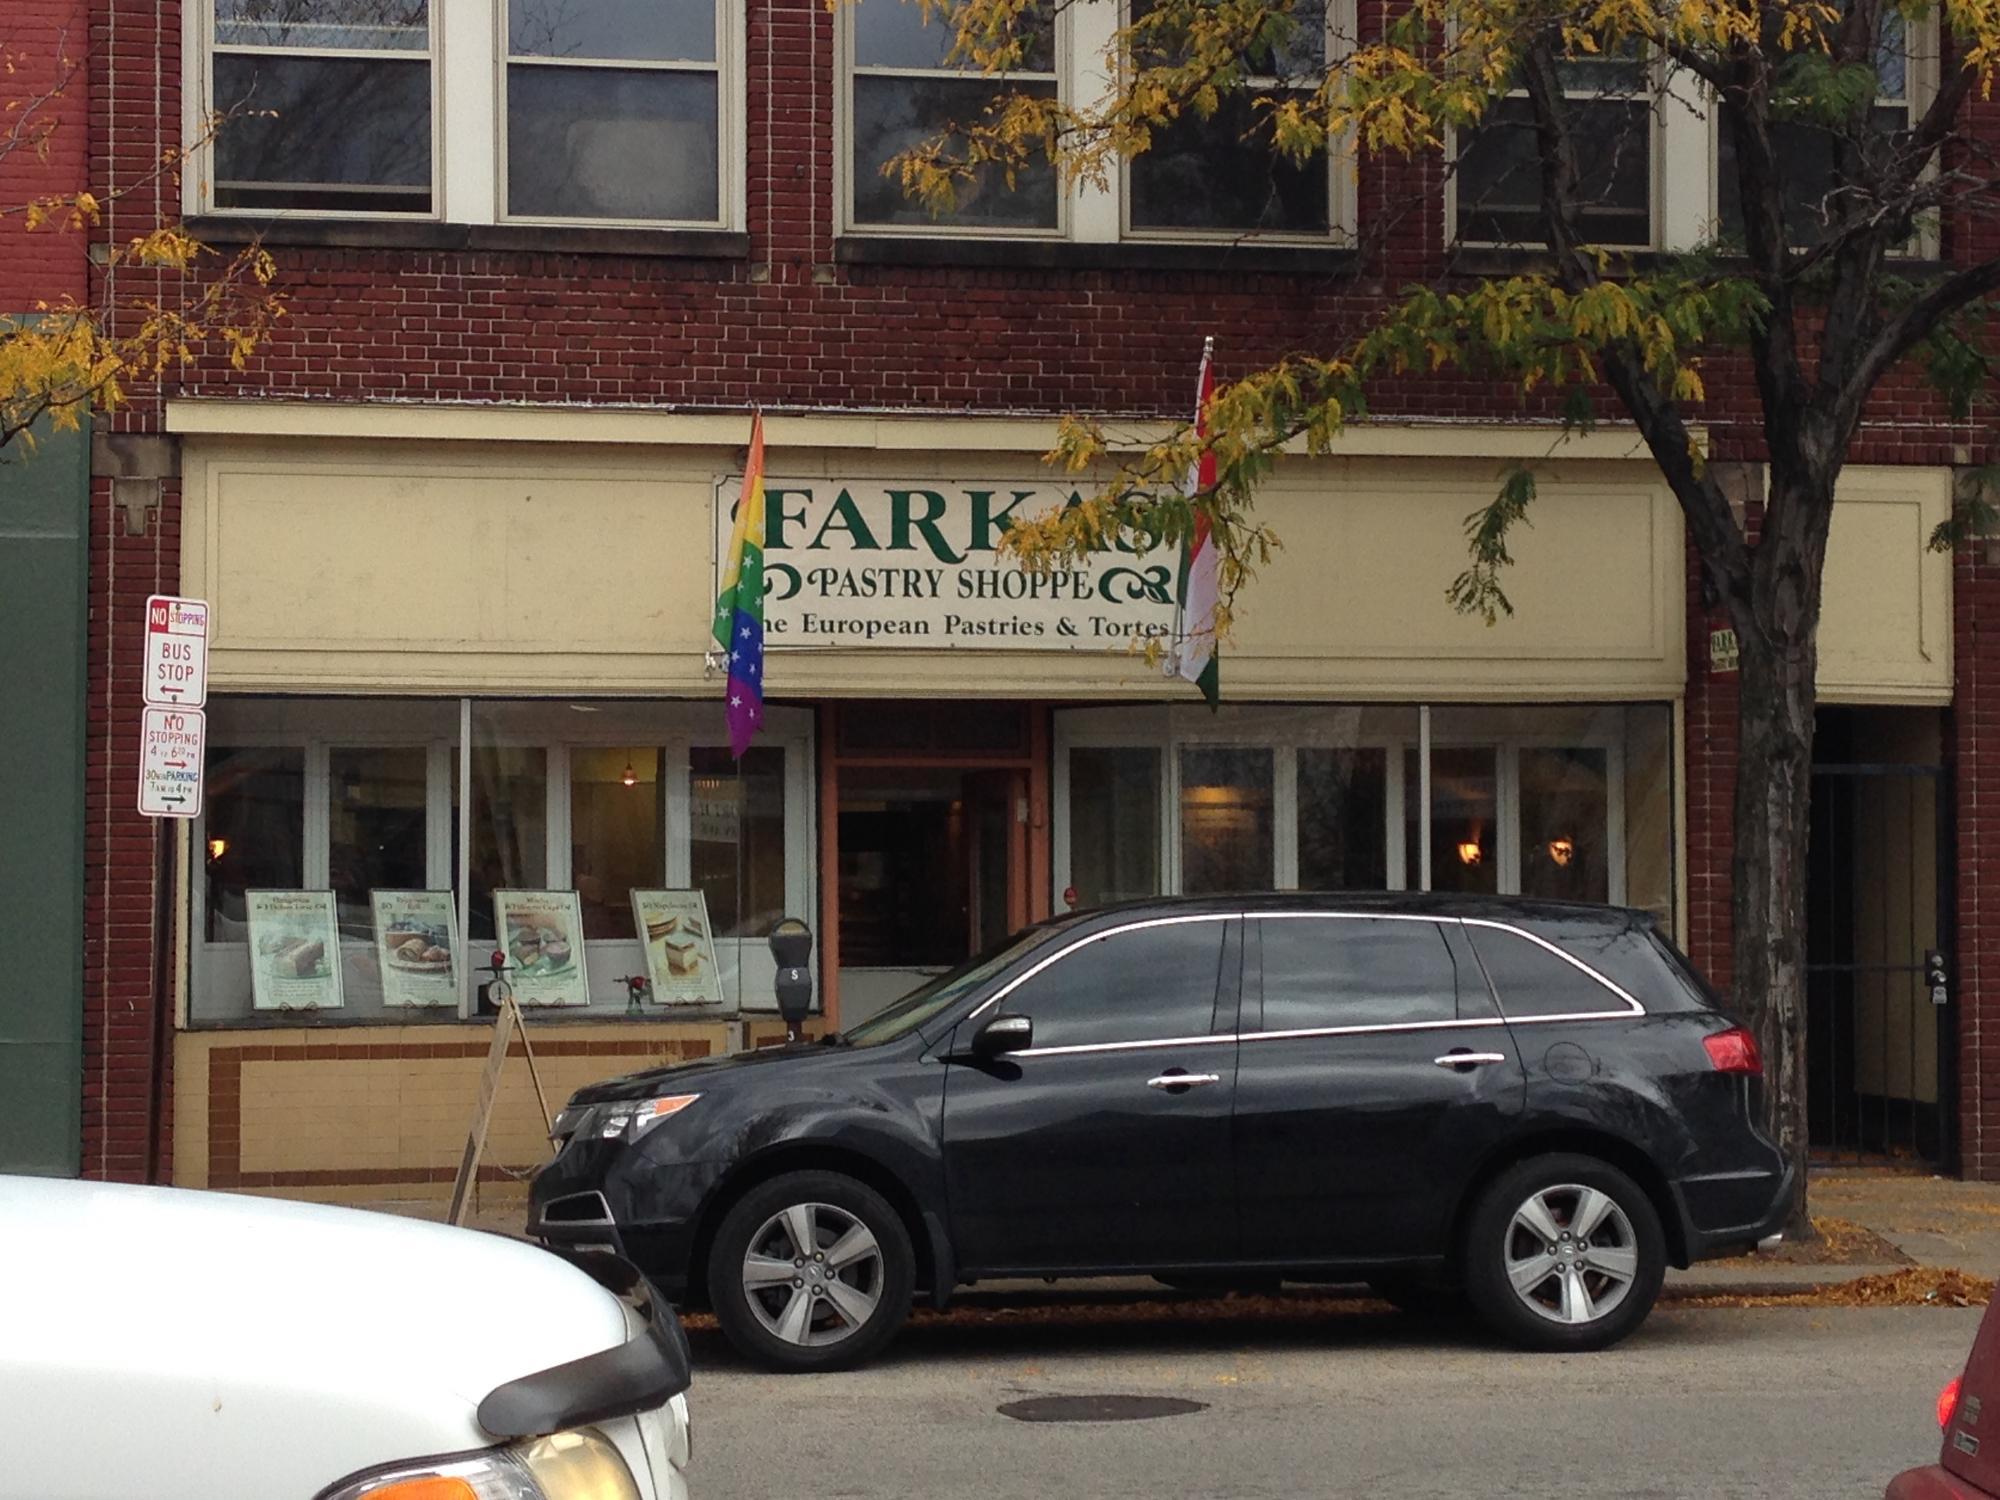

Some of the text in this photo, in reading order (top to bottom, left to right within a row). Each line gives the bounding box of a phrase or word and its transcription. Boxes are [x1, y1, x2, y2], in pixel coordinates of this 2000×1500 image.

[807, 567, 1094, 600] PASTRY SHOPPE
[151, 607, 205, 627] NO STOPPING
[802, 613, 930, 639] European
[944, 614, 1045, 636] Pastries
[1056, 616, 1079, 637] &
[1089, 616, 1169, 638] Tortes
[162, 642, 192, 661] BUS
[158, 663, 194, 682] STOP
[164, 715, 185, 731] NO
[149, 730, 198, 746] STOPPING
[166, 770, 198, 783] PARKING
